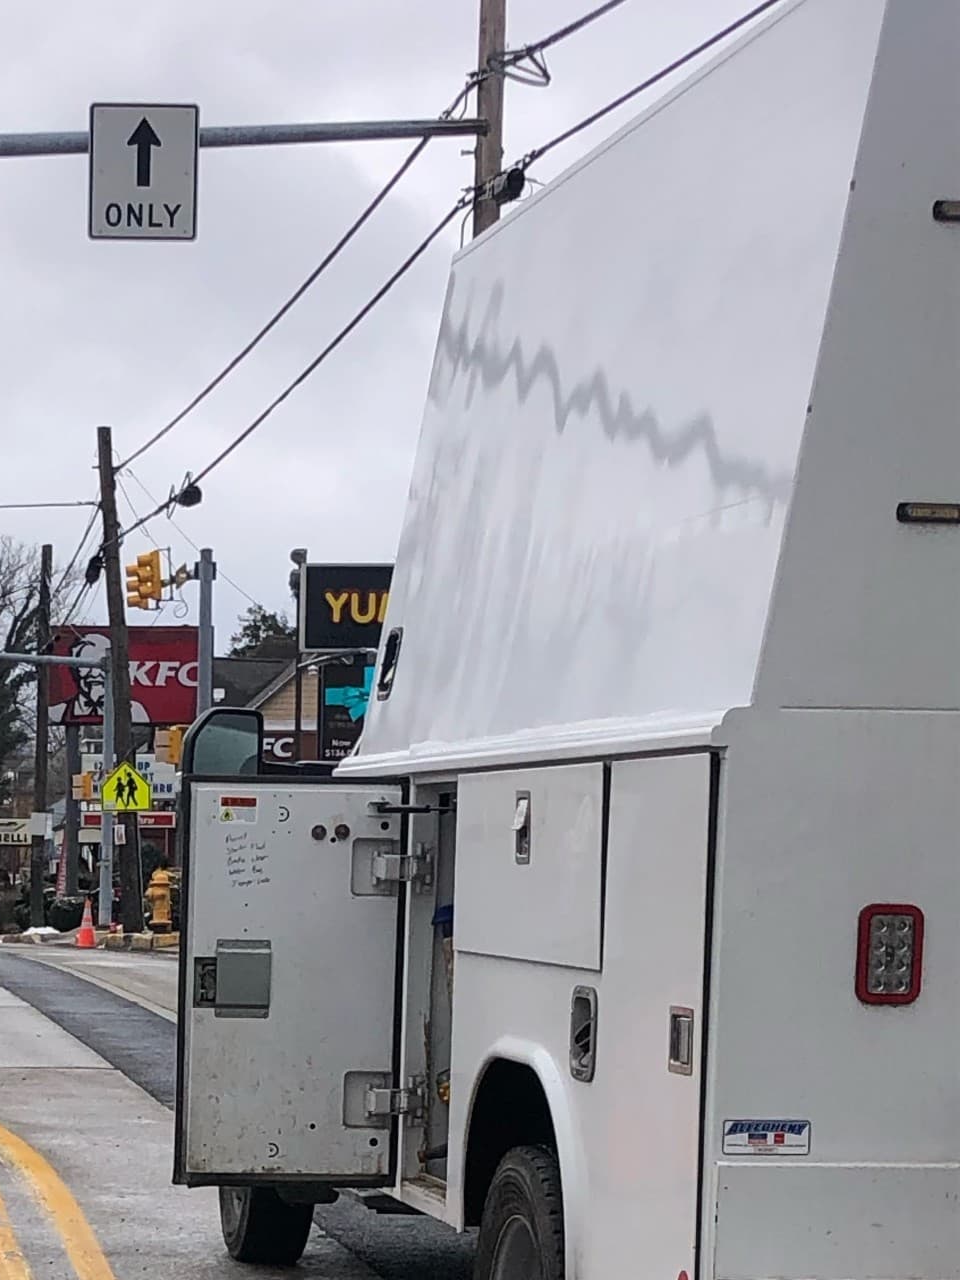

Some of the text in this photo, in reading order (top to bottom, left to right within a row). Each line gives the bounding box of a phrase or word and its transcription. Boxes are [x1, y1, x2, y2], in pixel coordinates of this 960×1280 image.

[105, 203, 182, 228] ONLY
[128, 661, 199, 687] KFC
[263, 737, 294, 757] FC
[153, 783, 173, 793] HRU
